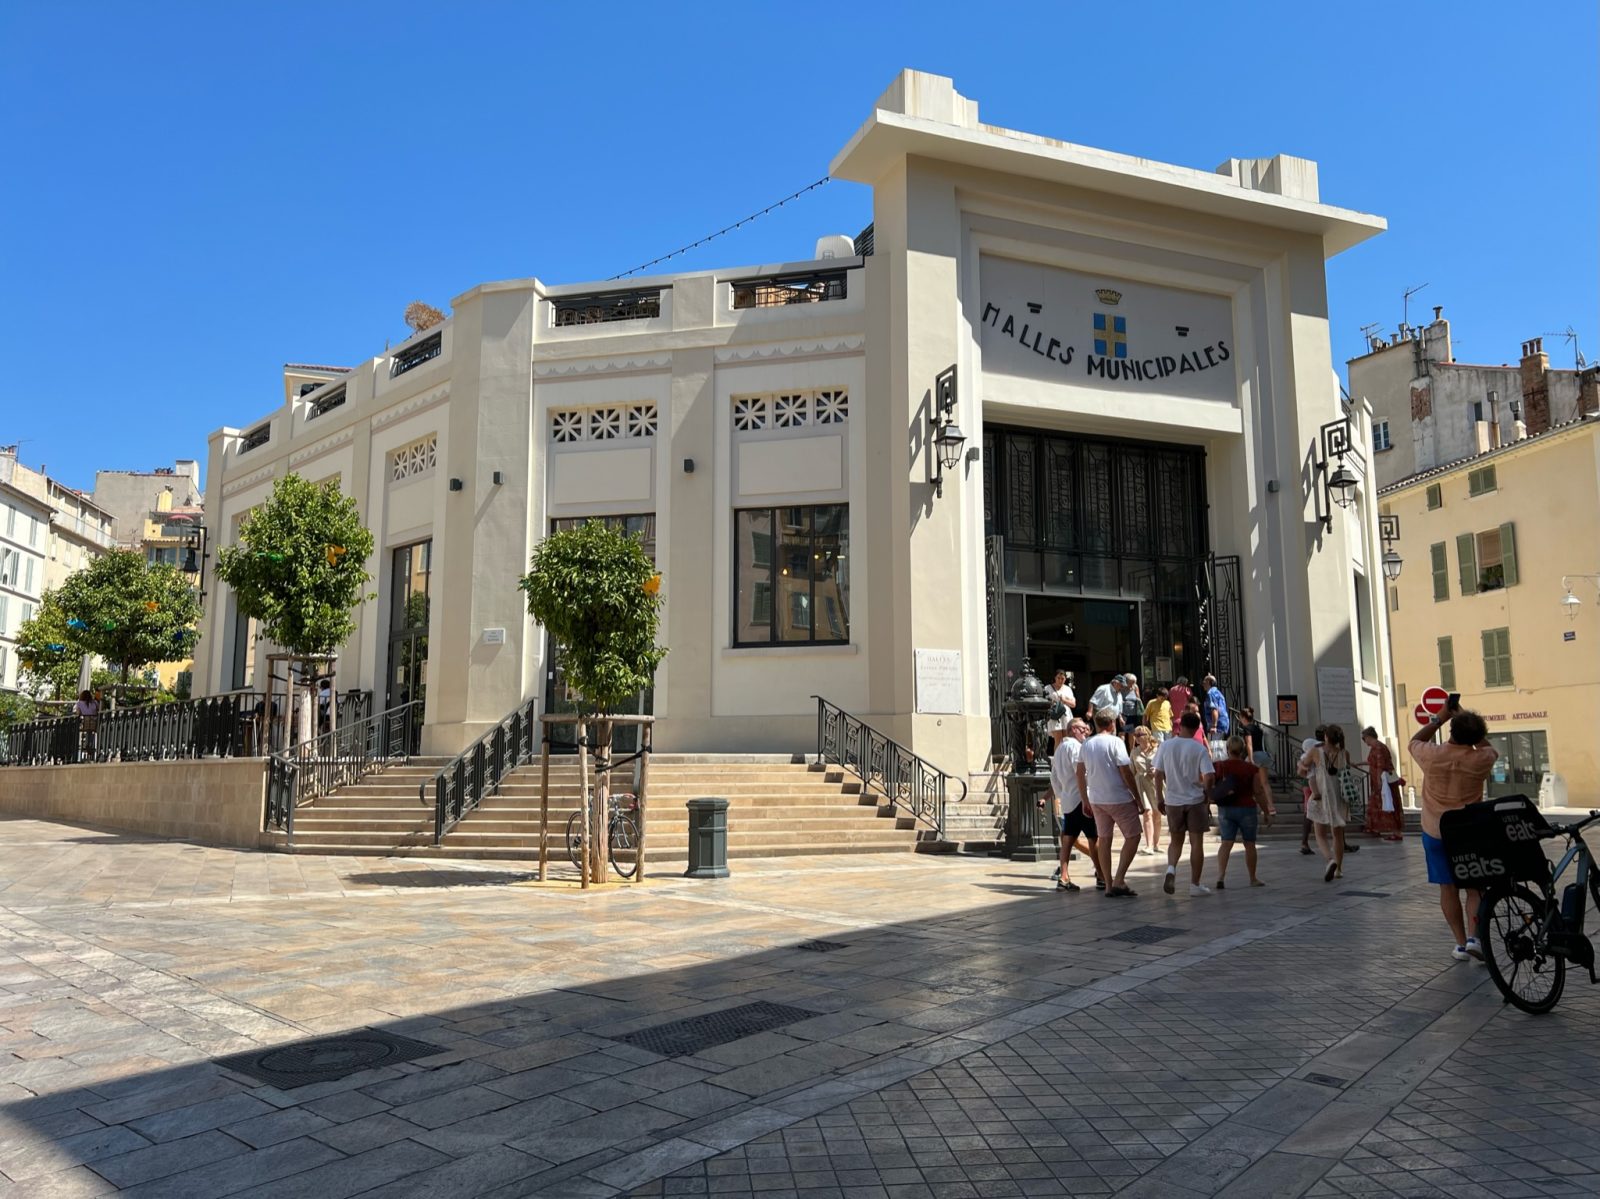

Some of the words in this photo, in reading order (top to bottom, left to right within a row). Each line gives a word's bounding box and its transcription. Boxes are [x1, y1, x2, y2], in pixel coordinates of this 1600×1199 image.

[982, 302, 1075, 365] HALLES
[1087, 340, 1231, 381] MUNICIPALES
[1505, 819, 1538, 842] eats
[1452, 853, 1477, 864] UBER
[1454, 856, 1506, 880] eats
